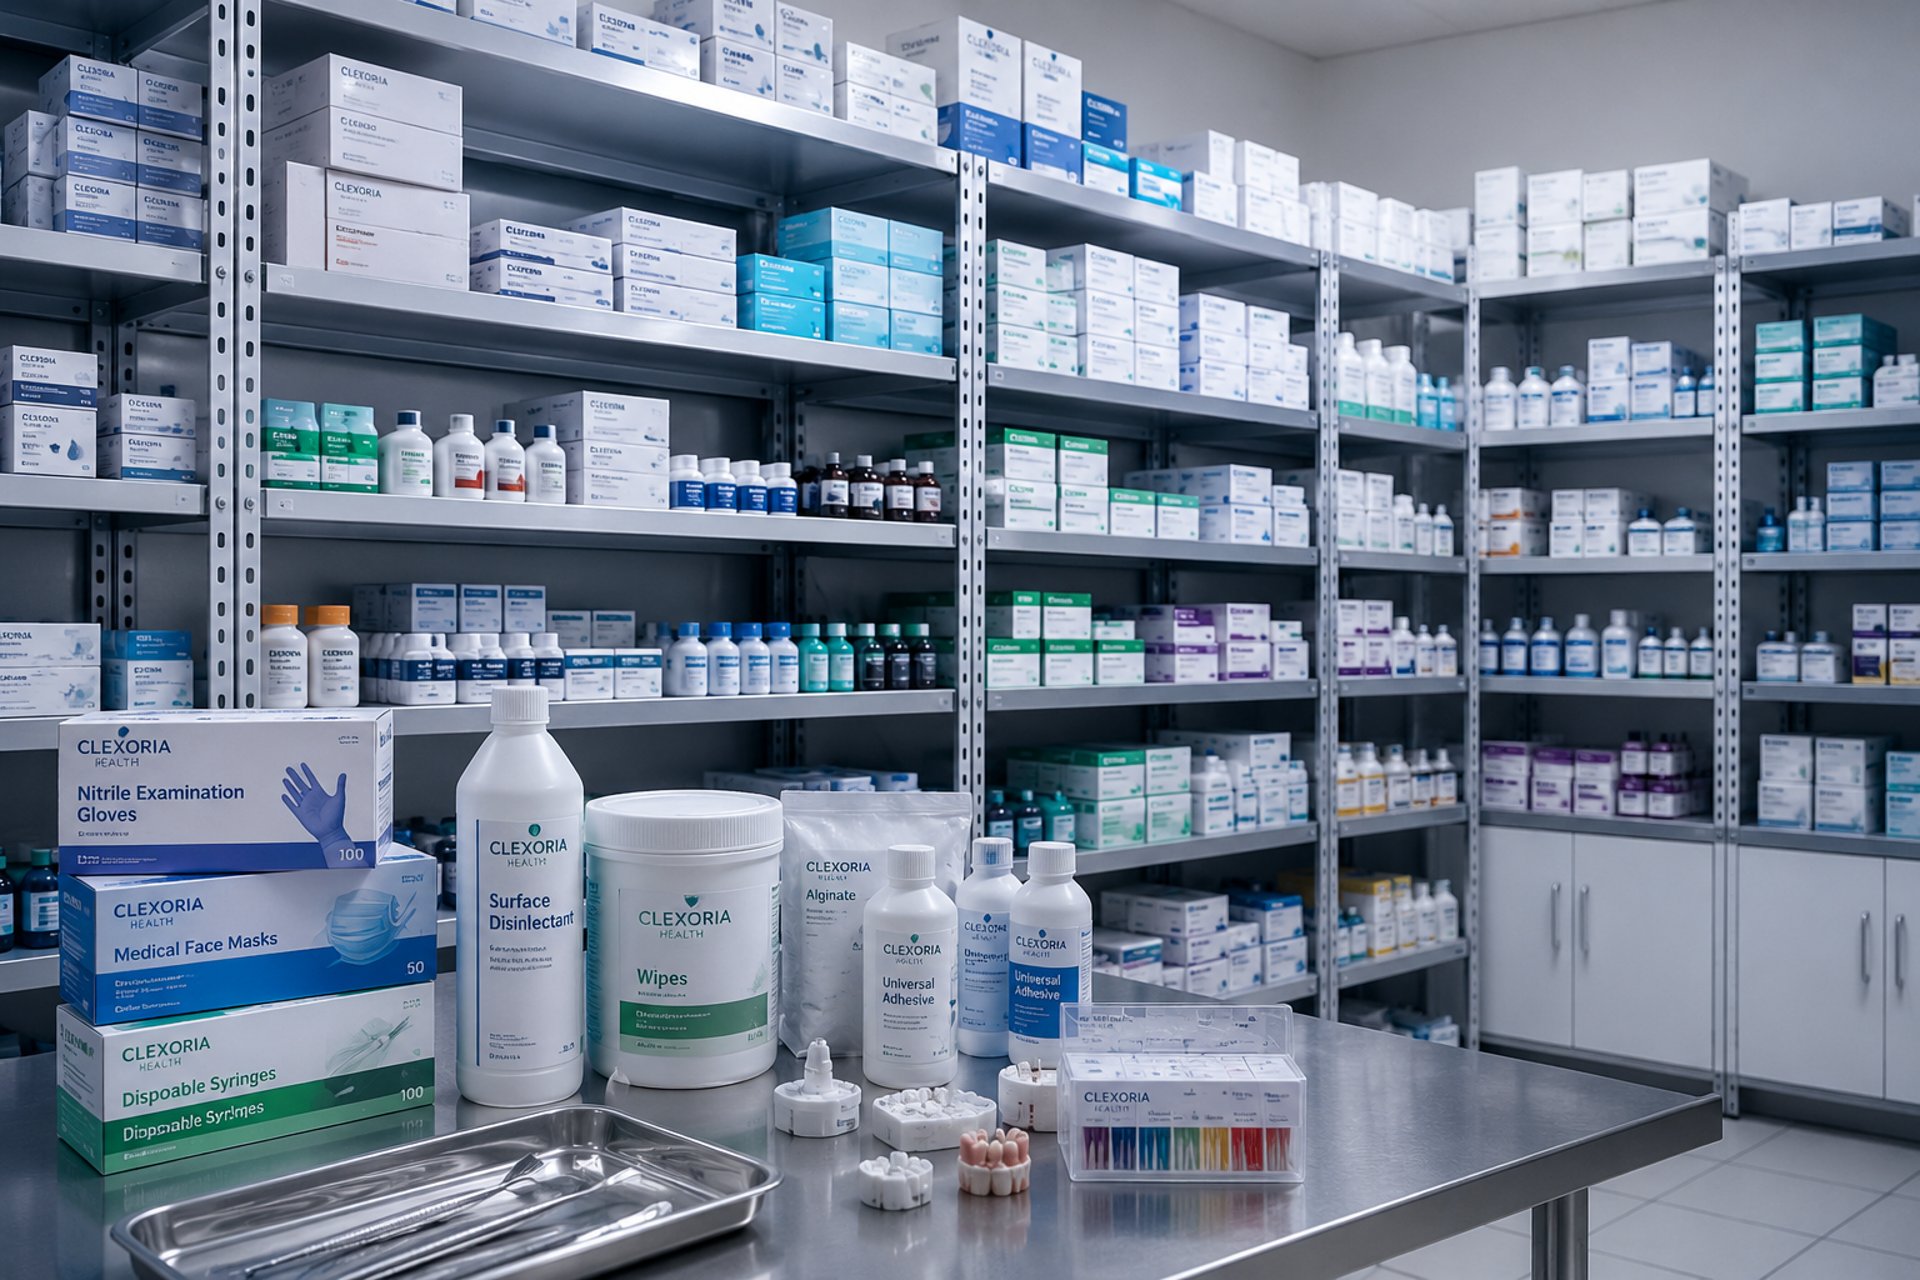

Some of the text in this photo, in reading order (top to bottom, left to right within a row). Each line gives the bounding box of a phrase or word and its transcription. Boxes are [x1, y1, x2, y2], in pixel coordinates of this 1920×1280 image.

[334, 181, 382, 199] CLEXORIA
[77, 739, 171, 755] CLEXORIA
[77, 784, 245, 801] Nitrile Examination
[77, 807, 137, 823] Gloves
[339, 847, 365, 861] 100
[489, 838, 568, 856] CLEXORIA
[806, 861, 872, 873] CLEXORIA
[489, 893, 551, 909] Surface
[806, 889, 856, 904] Alginate
[114, 897, 204, 919] CLEXORIA
[130, 917, 174, 929] HEALTH
[489, 910, 575, 931] Disinlectant
[638, 909, 732, 926] CLEXORIA
[659, 929, 704, 940] HEALTH
[114, 932, 277, 963] Medical Face Masks
[883, 943, 942, 956] CLEXORIA
[1015, 935, 1067, 951] CLEXORIA
[636, 968, 688, 989] Wipes
[883, 977, 935, 991] Universal
[882, 992, 935, 1006] Adhesive
[122, 1037, 211, 1063] CLEXORIA
[139, 1057, 182, 1072] HEALTH
[122, 1068, 277, 1107] Dispoable Syringes
[400, 1086, 424, 1102] 100
[1084, 1091, 1151, 1104] CLEXORIA
